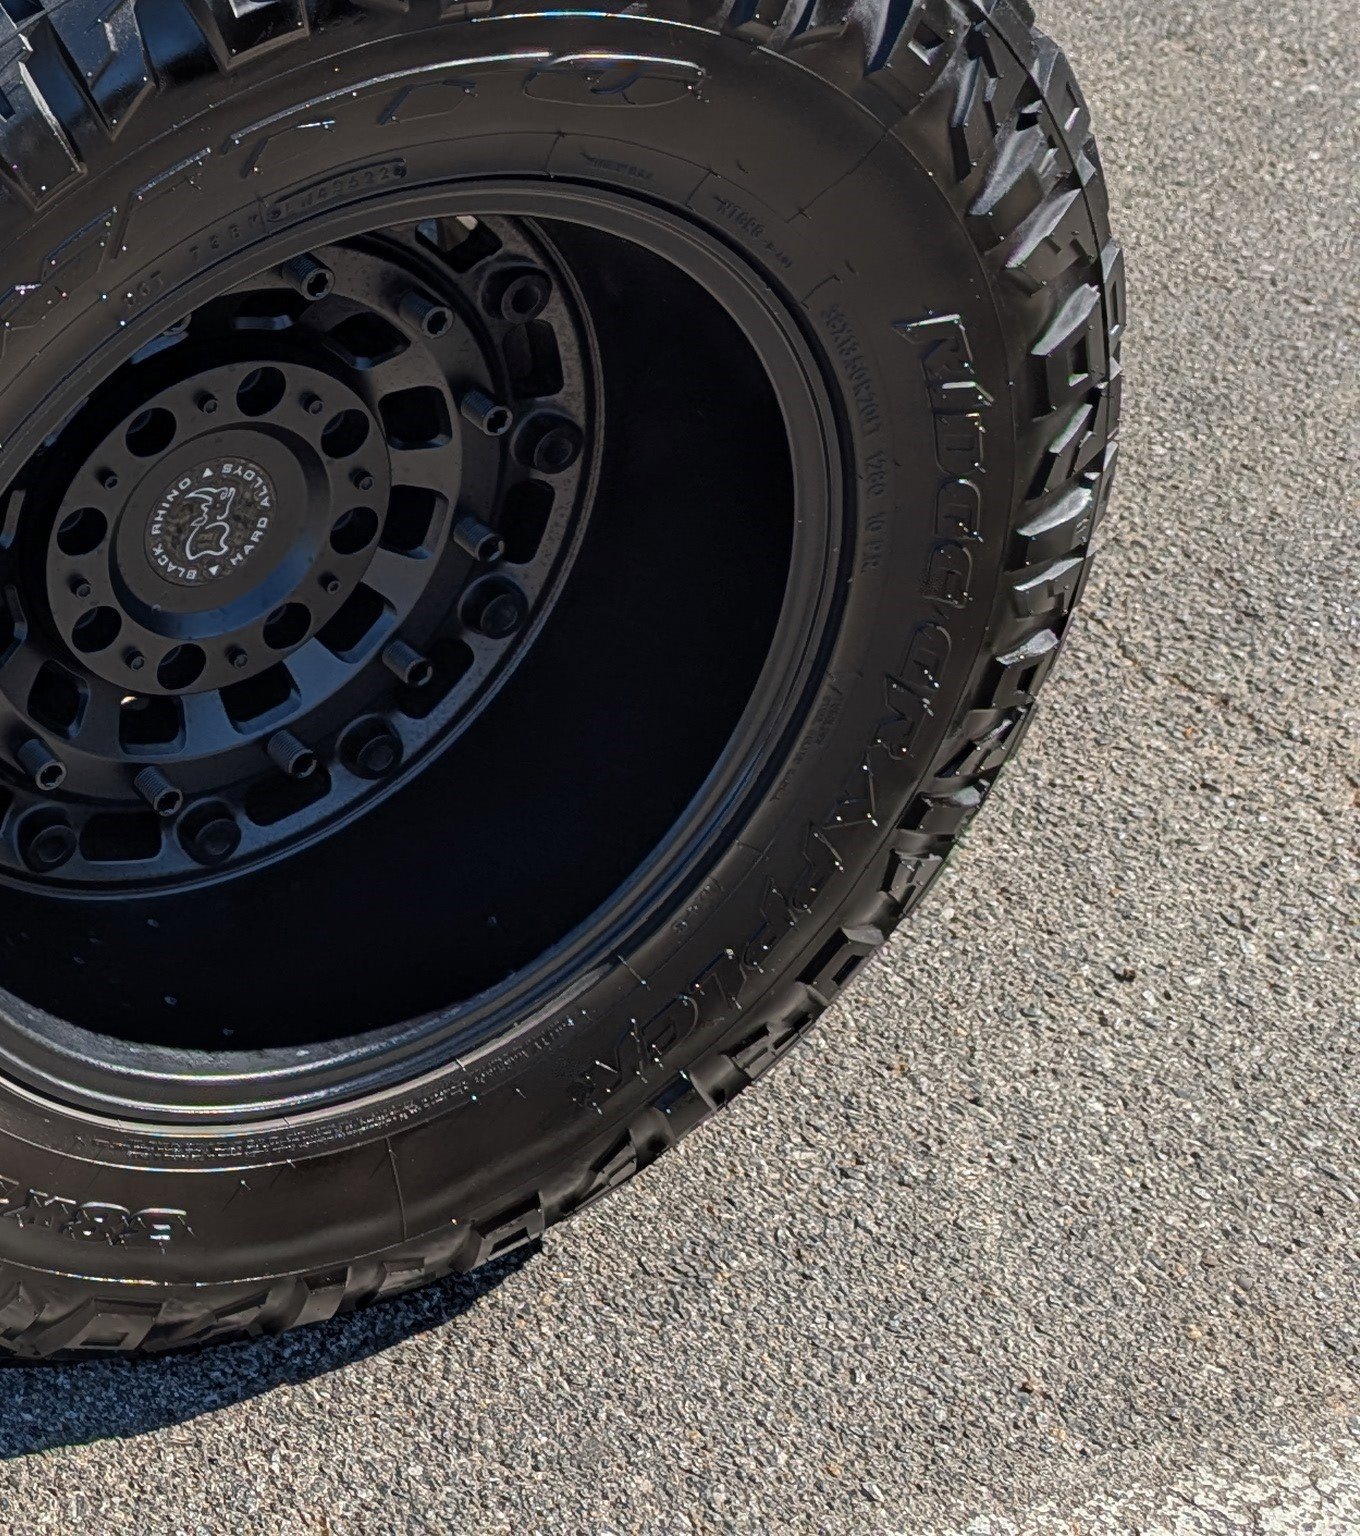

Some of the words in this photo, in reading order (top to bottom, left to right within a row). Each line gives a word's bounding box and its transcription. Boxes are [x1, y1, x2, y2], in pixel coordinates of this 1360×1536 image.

[221, 463, 271, 507] ALLOYS
[890, 312, 995, 610] RIDGE
[151, 476, 191, 535] RHINO
[152, 543, 198, 580] BLACK
[230, 517, 268, 566] HARD
[570, 616, 957, 1114] GRAPPLER
